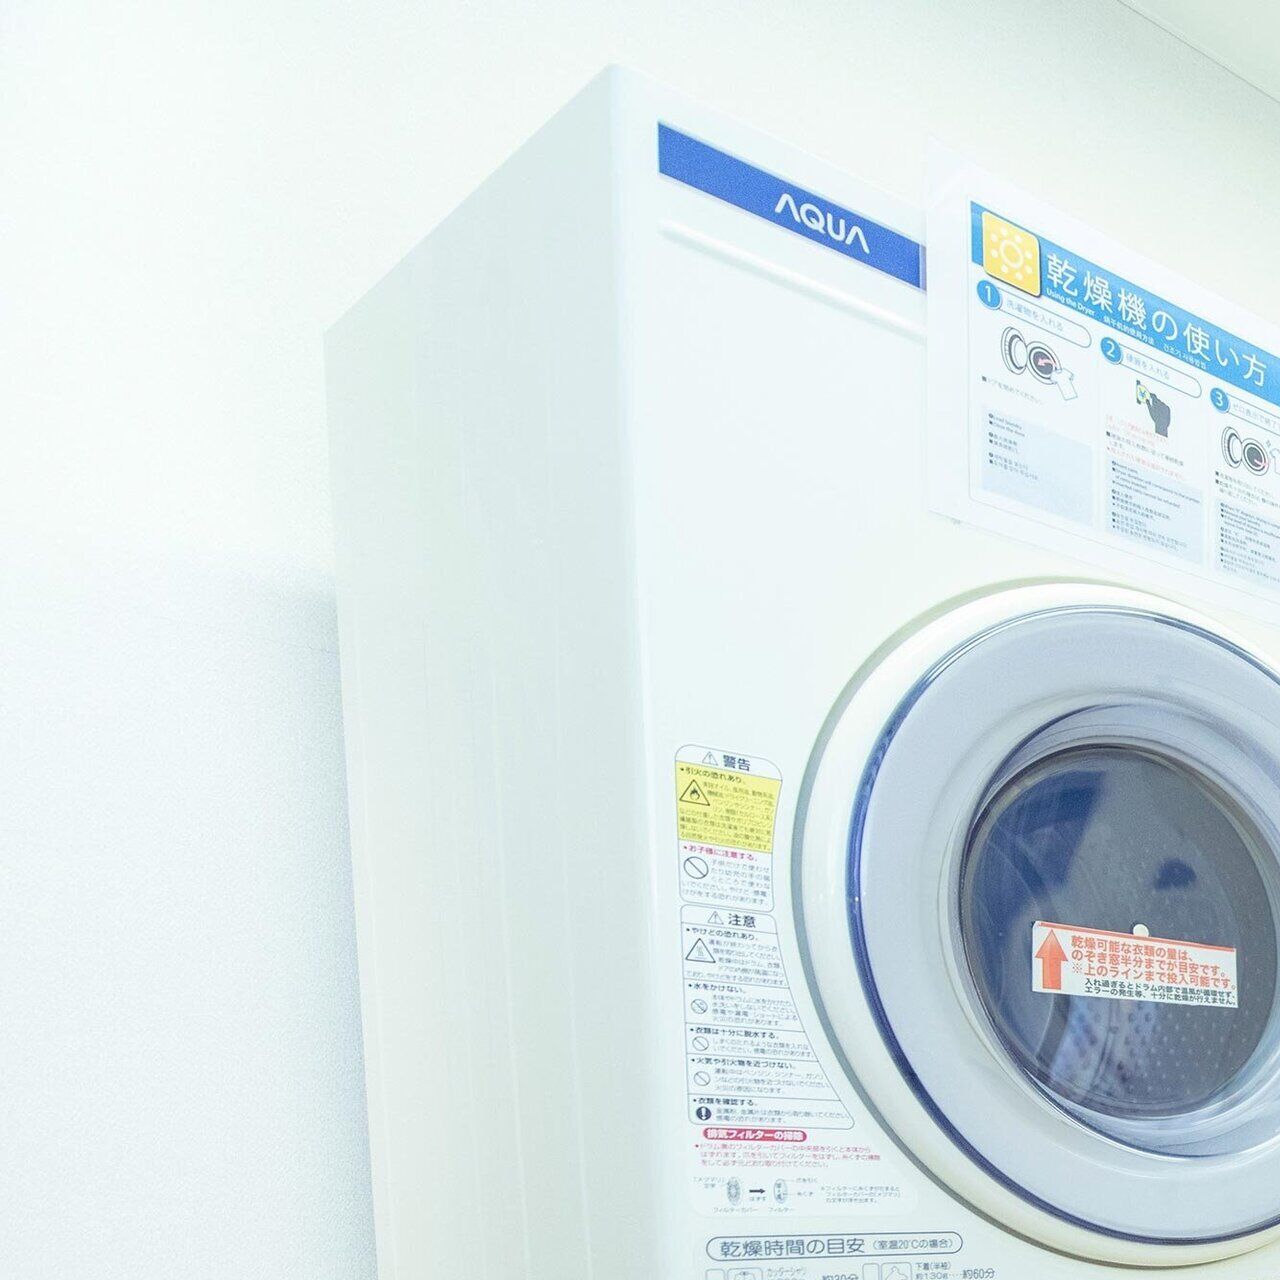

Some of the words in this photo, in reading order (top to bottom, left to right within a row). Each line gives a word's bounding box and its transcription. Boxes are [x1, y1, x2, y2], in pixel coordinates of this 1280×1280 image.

[774, 193, 870, 254] AQUA
[985, 285, 992, 303] 1
[1046, 287, 1065, 302] Using
[1078, 300, 1096, 317] Dryer
[1047, 252, 1267, 388] 乾燥機の使い方
[1106, 340, 1116, 358] 2
[1215, 391, 1224, 407] 3
[722, 754, 751, 772] 警告
[688, 845, 758, 862] お子様に注意する。
[728, 914, 756, 929] 注意
[691, 926, 758, 942] やけどの恐れあり。
[1070, 935, 1194, 961] 乾燥可能な衣類の量は、
[1071, 950, 1228, 978] のぞき窓半分までが目安です。
[1071, 964, 1236, 990] ※上のラインまで投入可能です。
[694, 982, 747, 994] 水をかけない。
[696, 1026, 780, 1040] 衣類は十分に脱水する。
[697, 1057, 796, 1070] 火気や引火物を近づけない。
[698, 1097, 758, 1107] 衣類を確認する。
[707, 1129, 805, 1142] 排気フィルターの掃除
[719, 1237, 866, 1258] 乾燥時間の目安
[962, 1268, 996, 1280] 約60分
